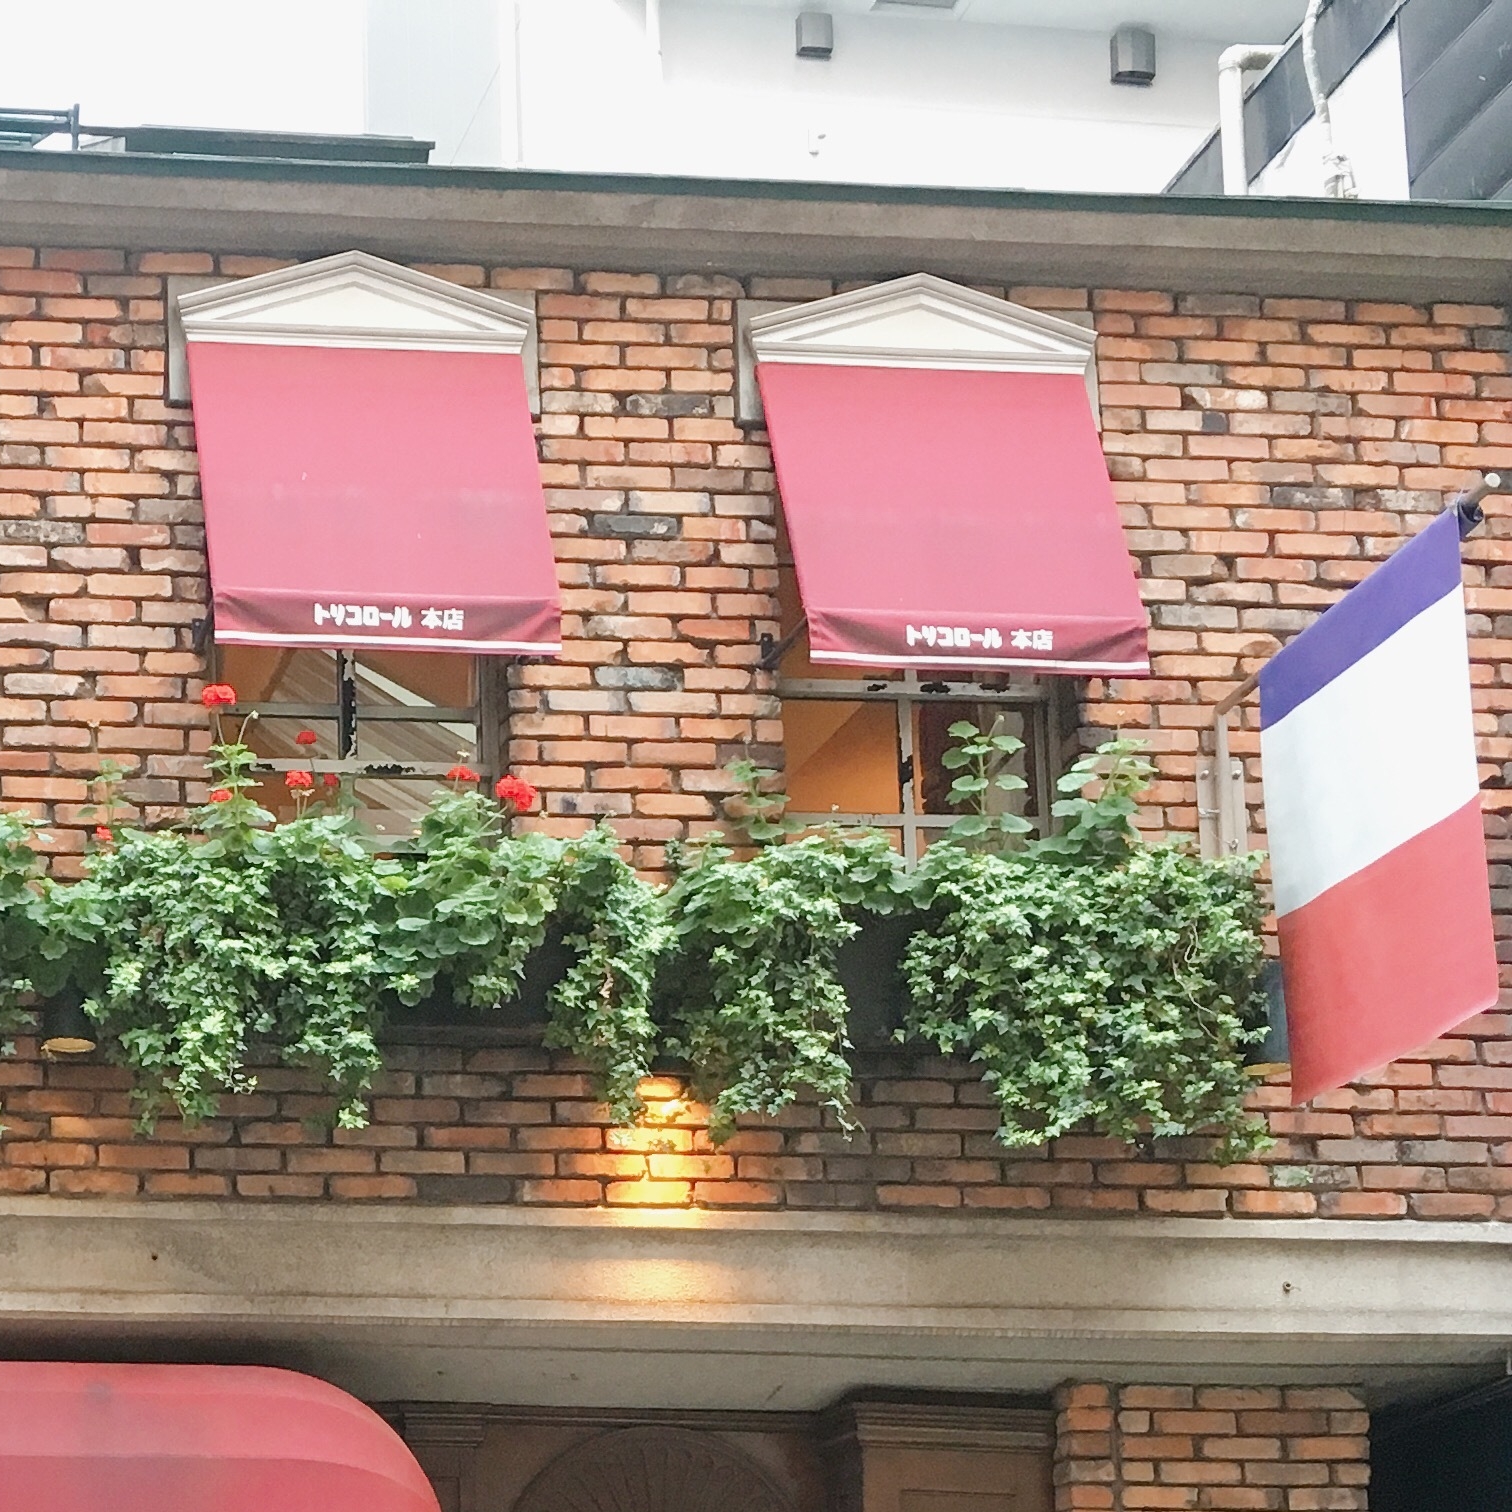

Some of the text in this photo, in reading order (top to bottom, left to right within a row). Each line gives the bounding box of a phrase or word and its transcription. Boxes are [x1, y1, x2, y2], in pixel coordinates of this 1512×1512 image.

[314, 602, 464, 631] トリコロール 本店
[905, 624, 1054, 651] トリコロール 本店
